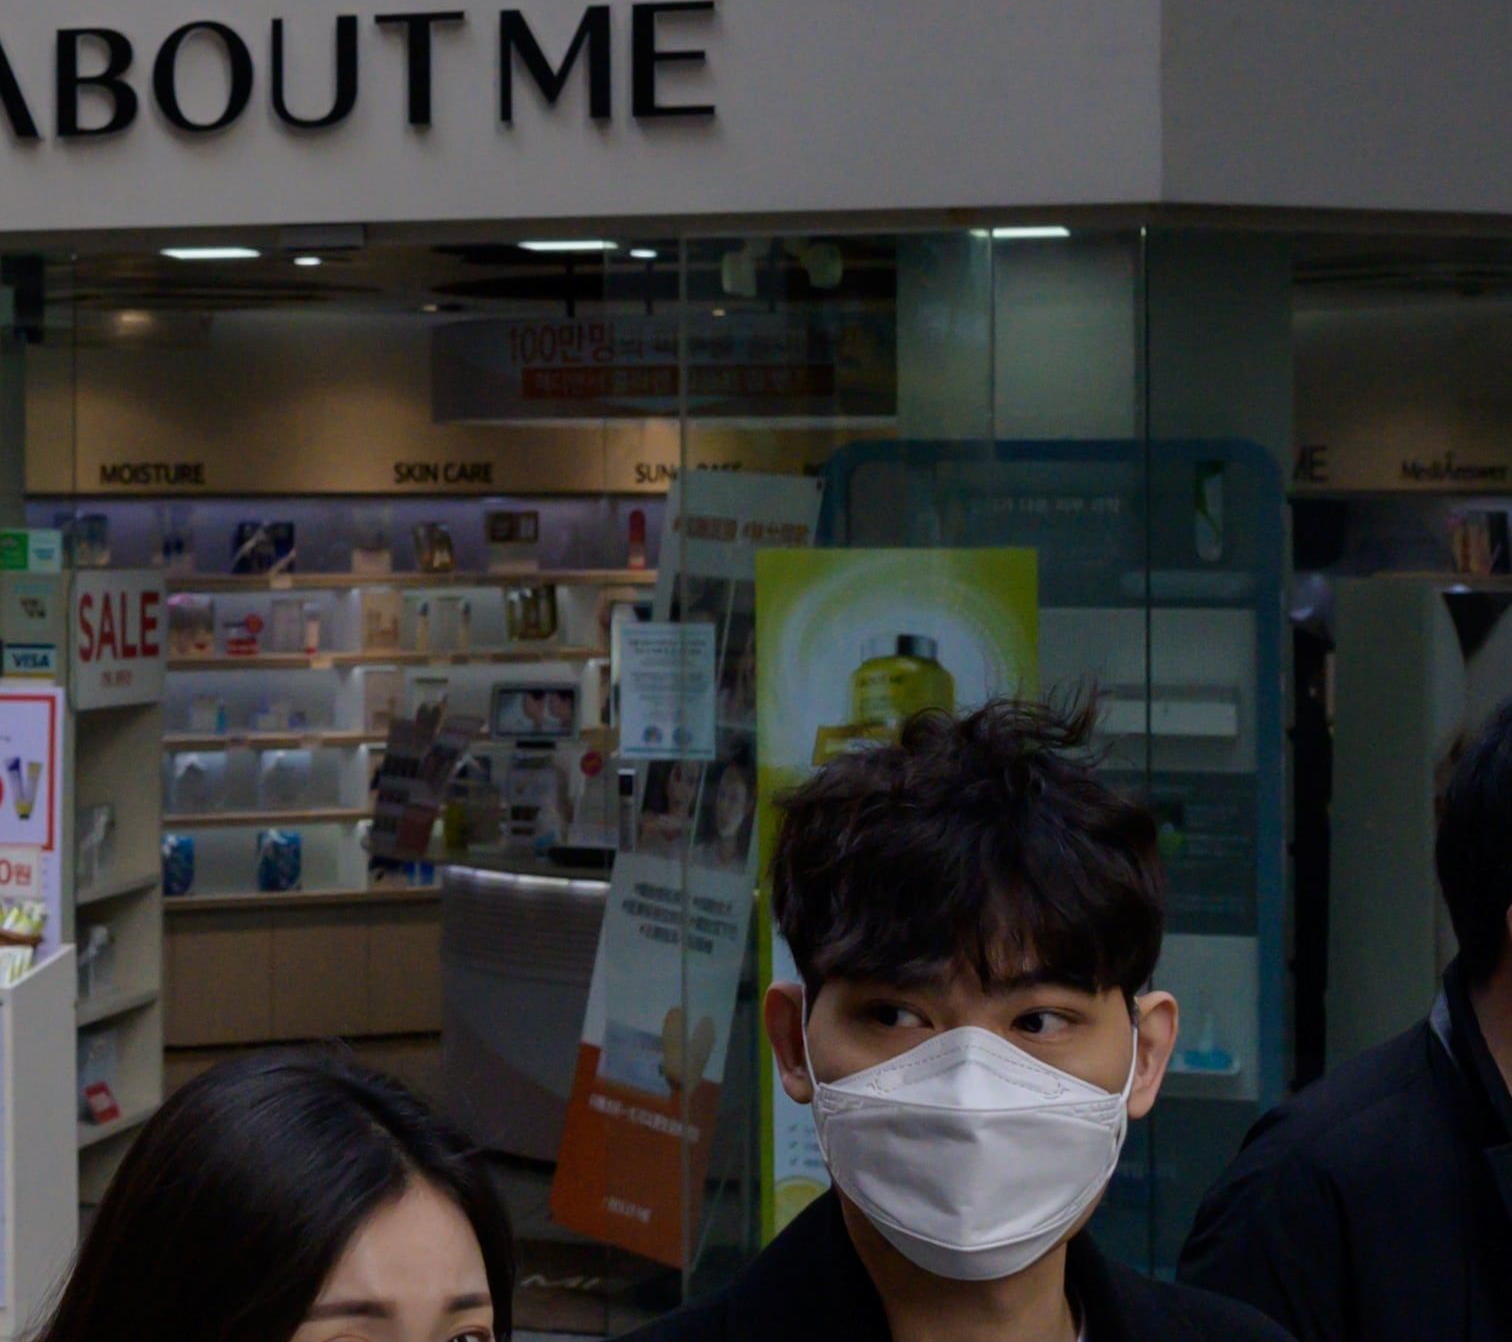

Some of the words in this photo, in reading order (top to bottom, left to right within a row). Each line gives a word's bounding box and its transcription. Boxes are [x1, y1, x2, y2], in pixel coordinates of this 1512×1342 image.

[500, 0, 716, 123] ME
[99, 462, 207, 487] MOISTURE
[394, 462, 439, 484] SKIN
[442, 462, 494, 484] CARE
[78, 589, 161, 662] SALE
[12, 650, 52, 668] VISA
